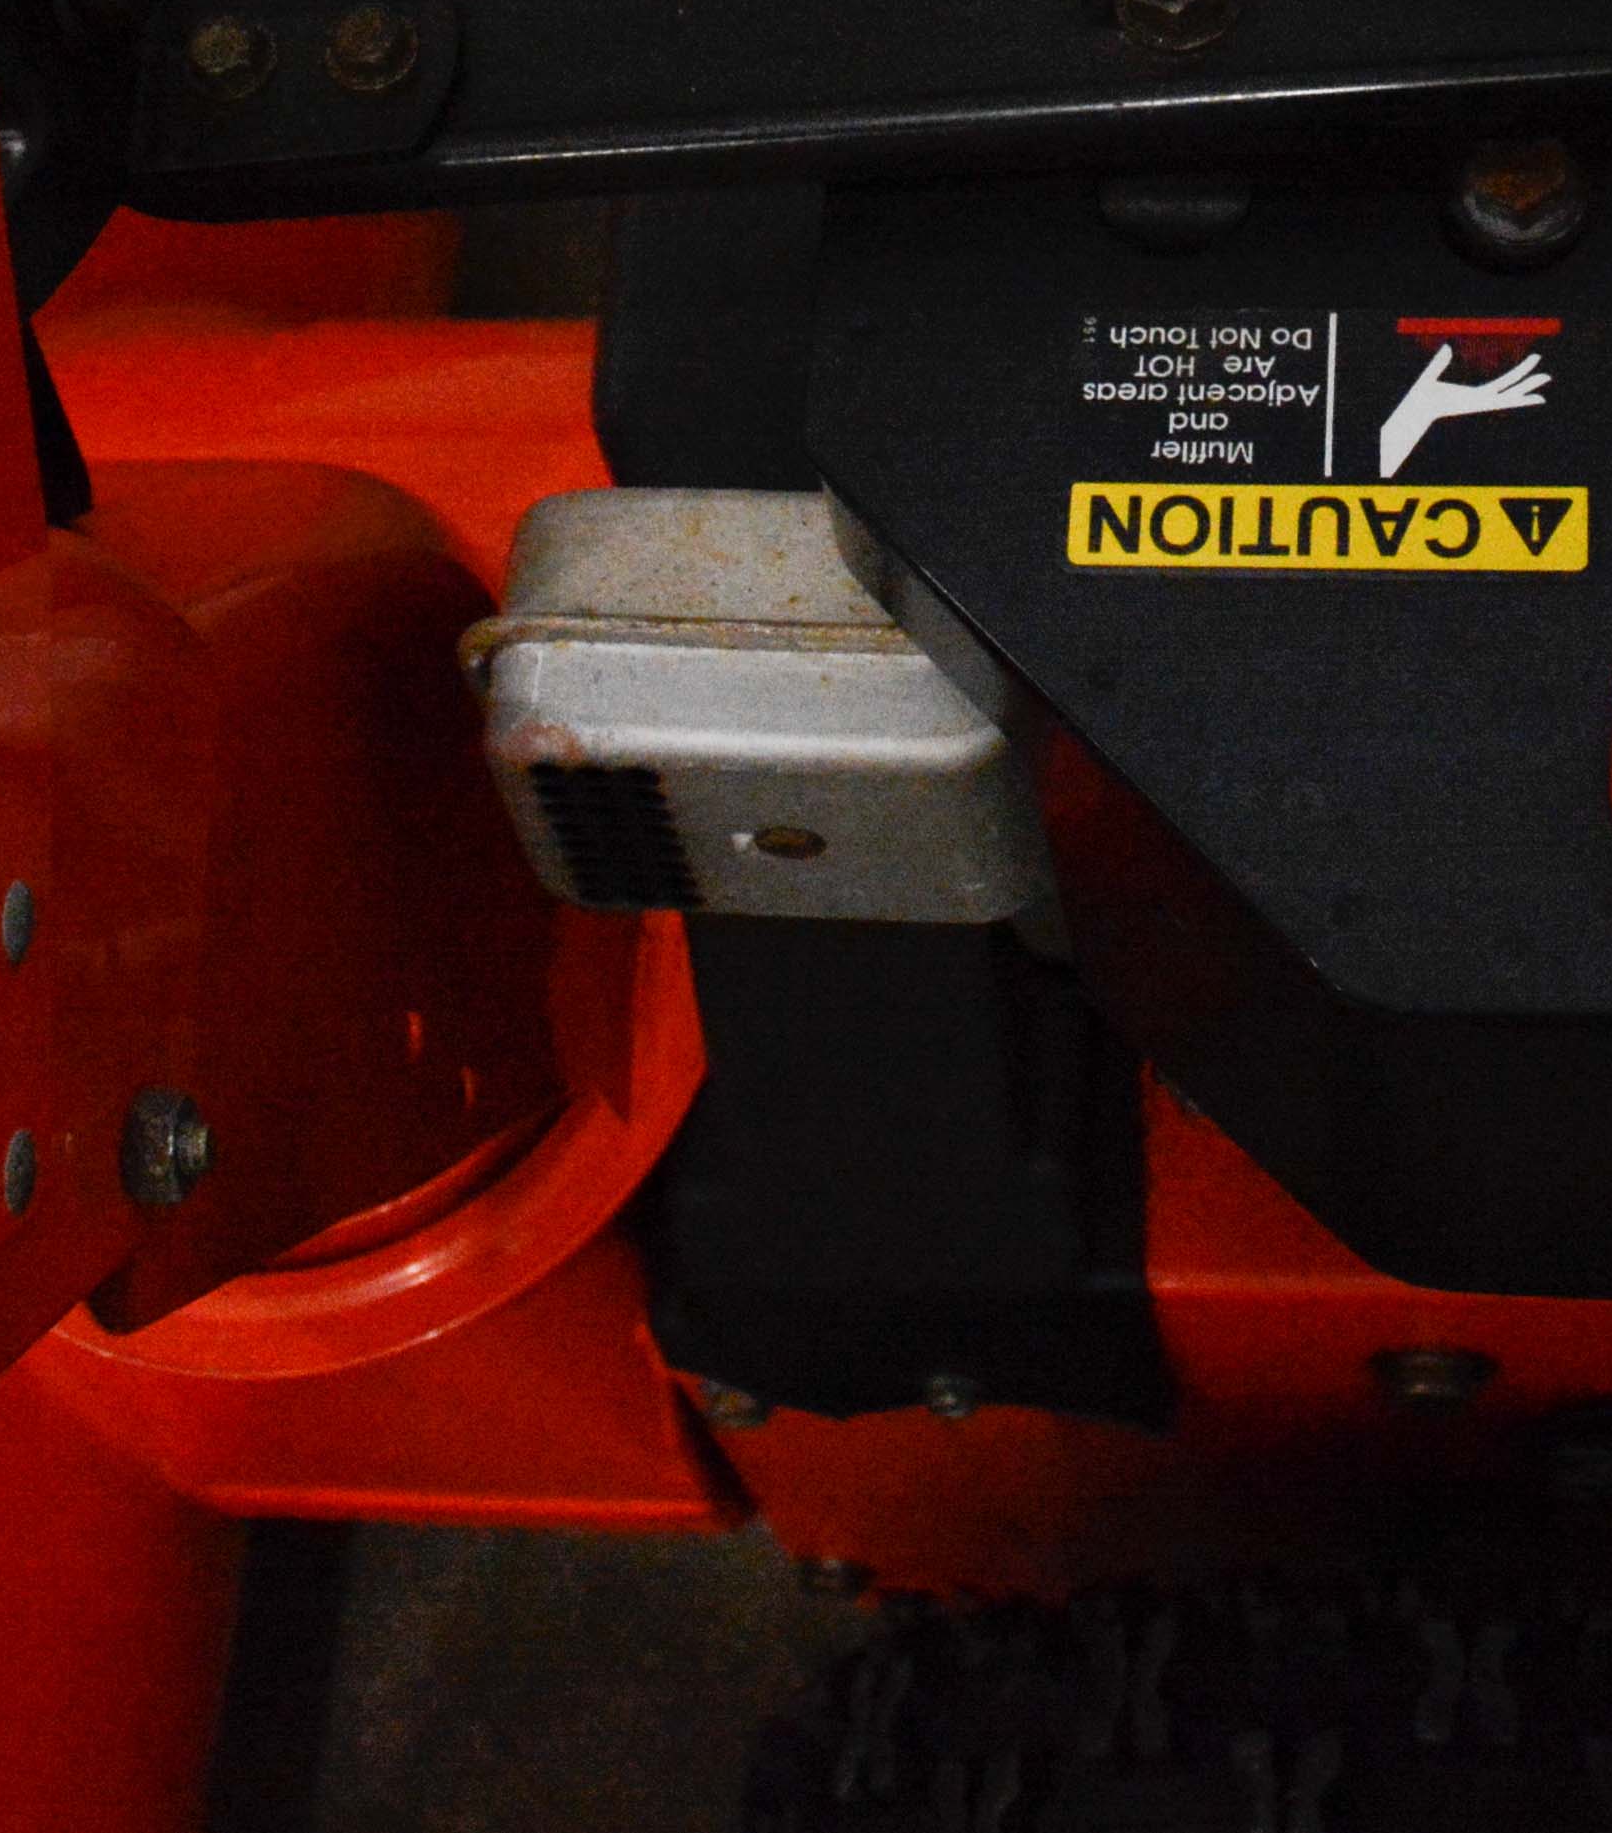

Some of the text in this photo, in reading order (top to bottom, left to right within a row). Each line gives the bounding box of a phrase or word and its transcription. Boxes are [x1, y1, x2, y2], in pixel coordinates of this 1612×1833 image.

[1109, 325, 1313, 351] Do Not Touch
[1133, 354, 1277, 379] Are HOT
[1082, 379, 1321, 407] Adjacent areas
[1167, 411, 1230, 434] and
[1150, 440, 1254, 465] Muffler
[1087, 493, 1481, 560] CAUTION
